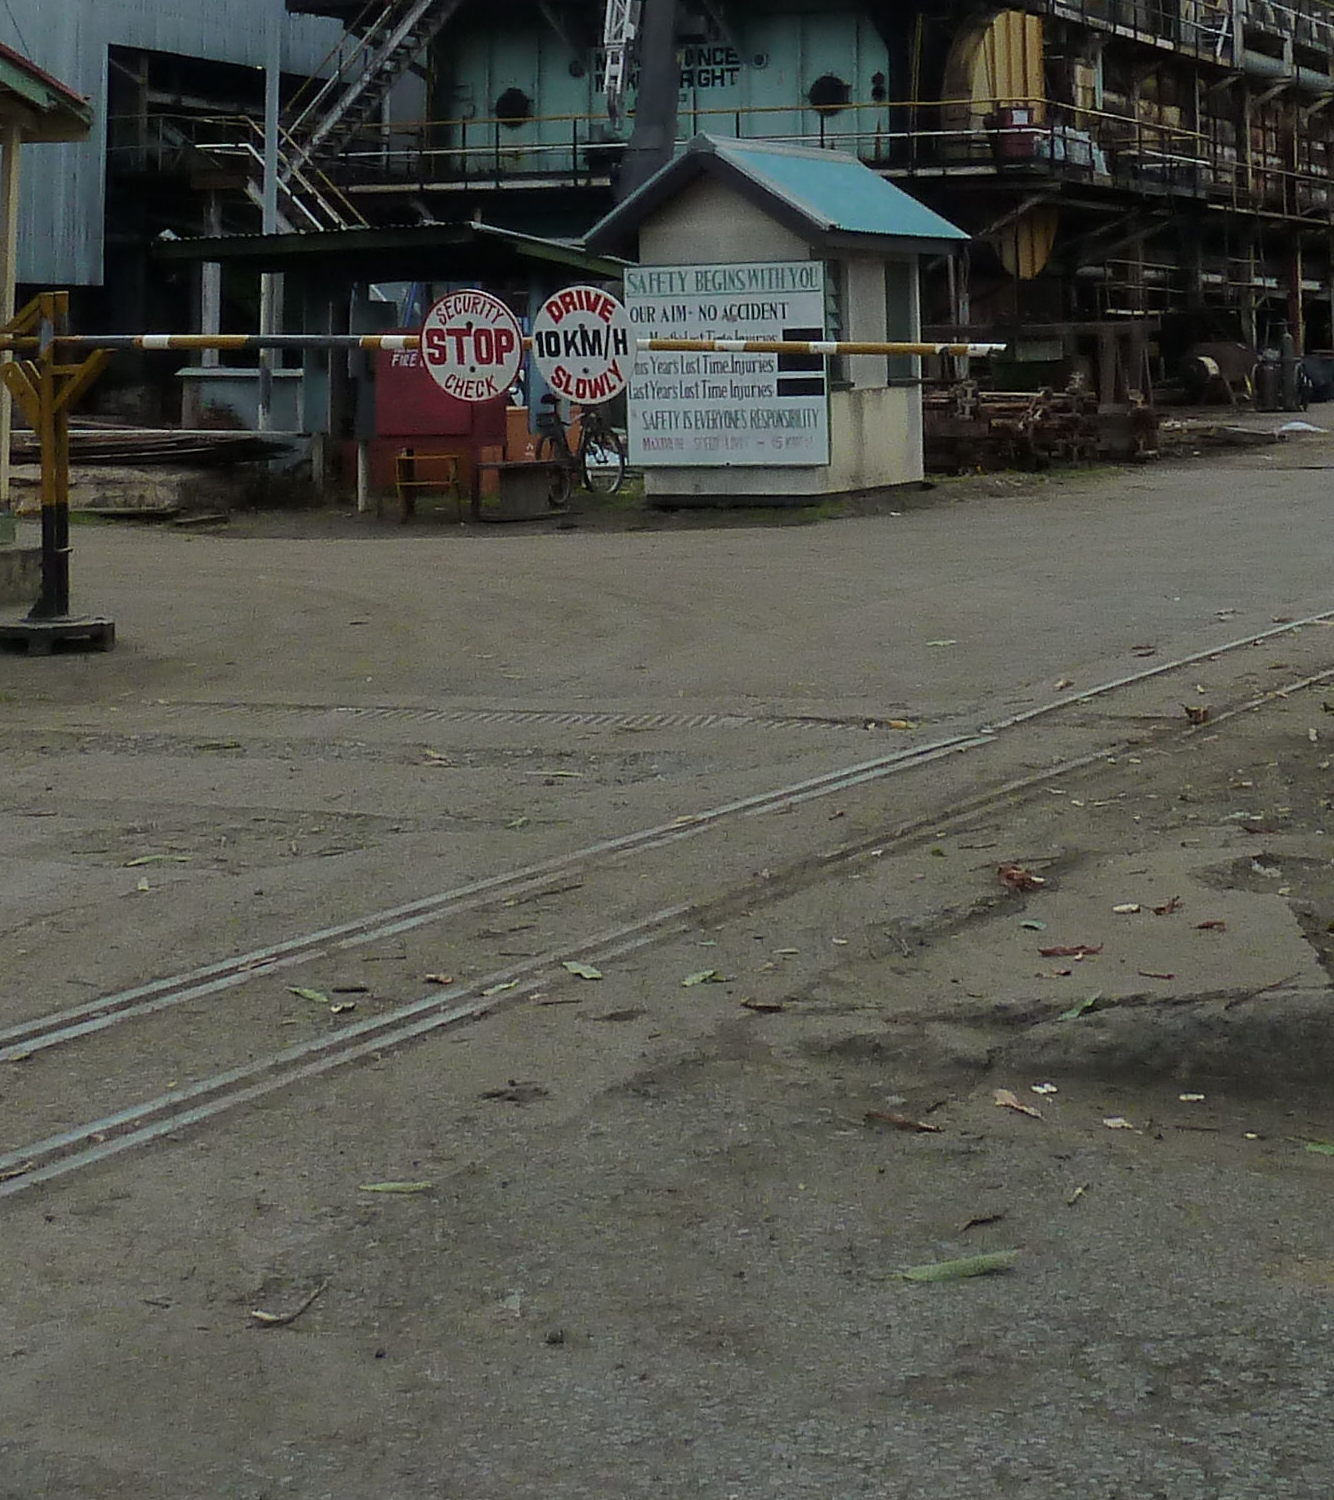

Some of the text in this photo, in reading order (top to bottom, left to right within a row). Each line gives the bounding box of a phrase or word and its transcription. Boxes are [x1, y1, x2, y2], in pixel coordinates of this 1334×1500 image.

[627, 265, 819, 294] SAFETY BEGINS WITH YOU
[435, 294, 505, 326] SECURITY
[545, 289, 616, 325] DRIVE
[629, 306, 655, 323] OUR
[698, 304, 718, 322] NO
[722, 301, 790, 321] ACCIDENT
[425, 328, 514, 365] STOP
[535, 330, 560, 358] 10
[565, 325, 629, 360] KM/H
[391, 353, 418, 368] FIRE
[680, 354, 701, 375] Lost
[702, 354, 730, 375] Time
[730, 353, 775, 377] Injuries
[444, 373, 500, 399] CHECK
[551, 358, 624, 400] SLOWLY
[679, 379, 700, 400] Lost
[700, 379, 728, 400] Time
[729, 378, 774, 401] Injuries
[642, 410, 680, 431] SAFETY
[683, 410, 692, 430] IS
